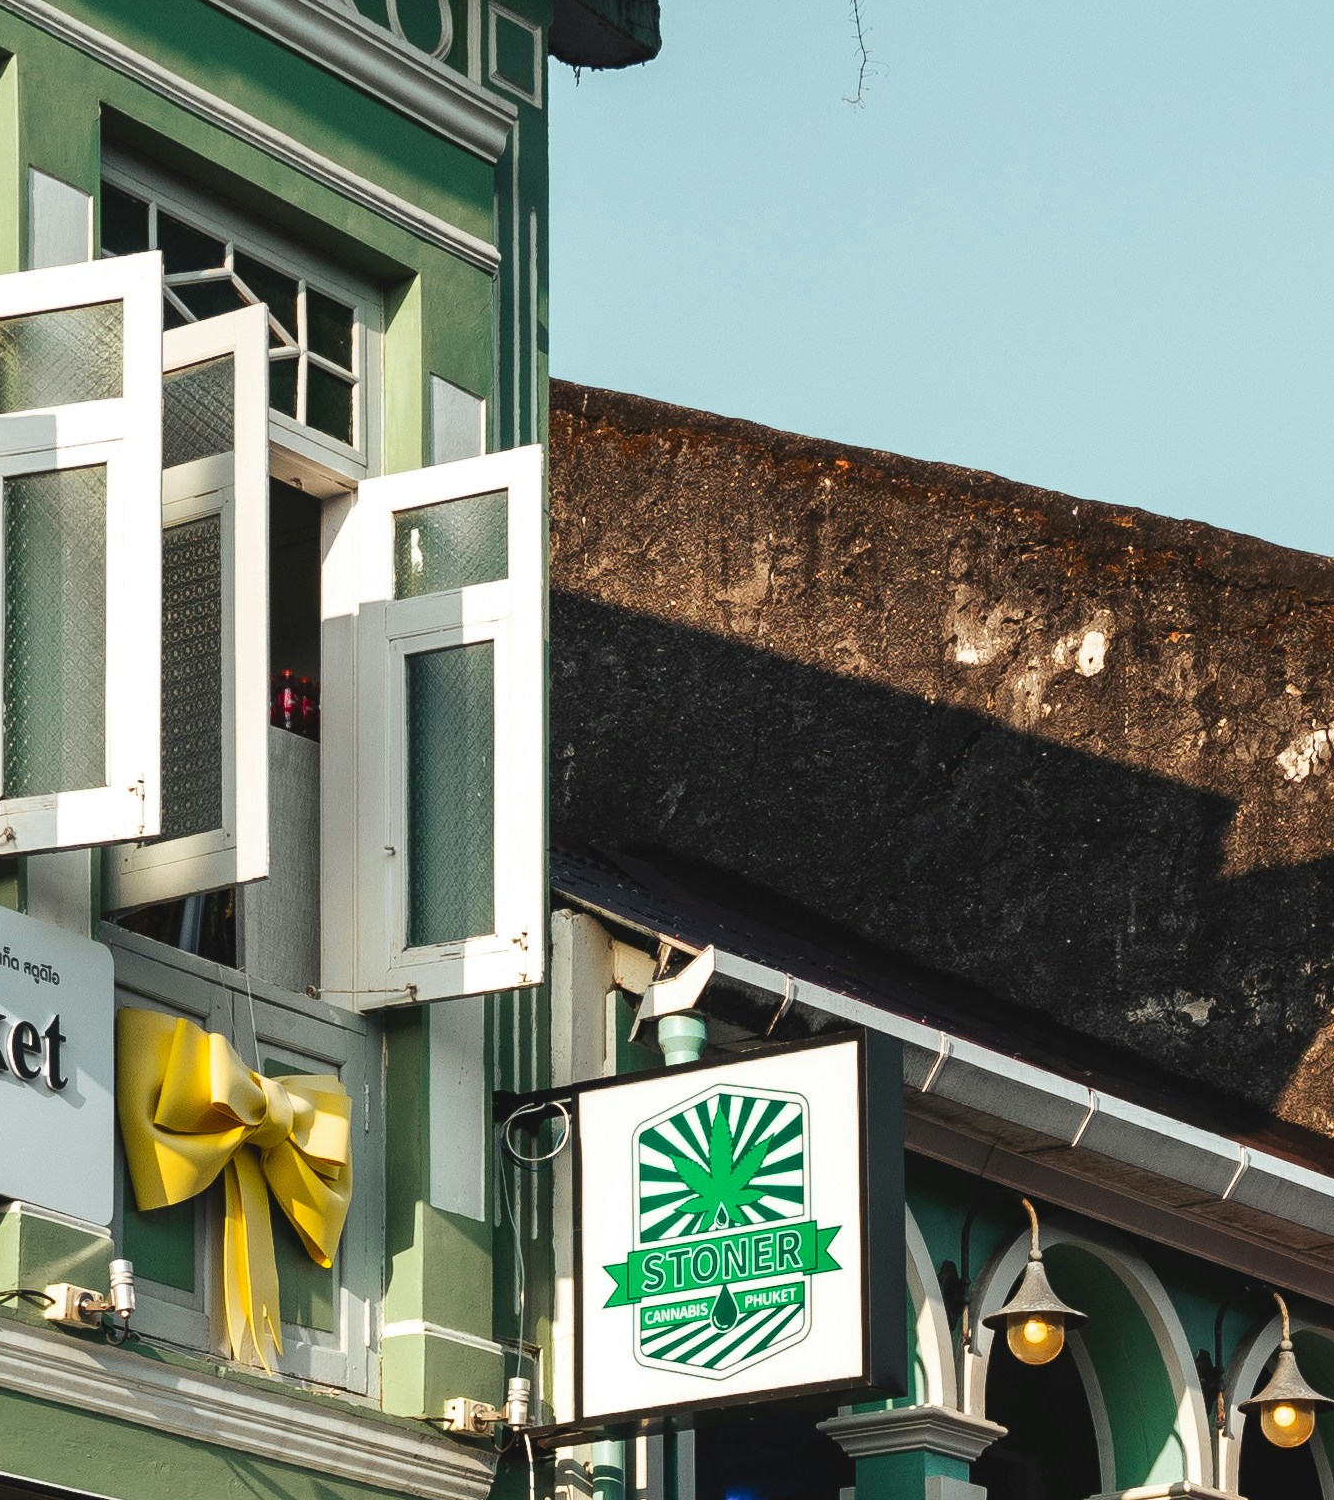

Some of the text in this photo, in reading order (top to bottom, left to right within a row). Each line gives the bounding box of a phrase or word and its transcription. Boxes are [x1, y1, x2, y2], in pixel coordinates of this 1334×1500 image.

[641, 1229, 803, 1293] STONER
[644, 1287, 799, 1326] CANNABIS PHUKET
